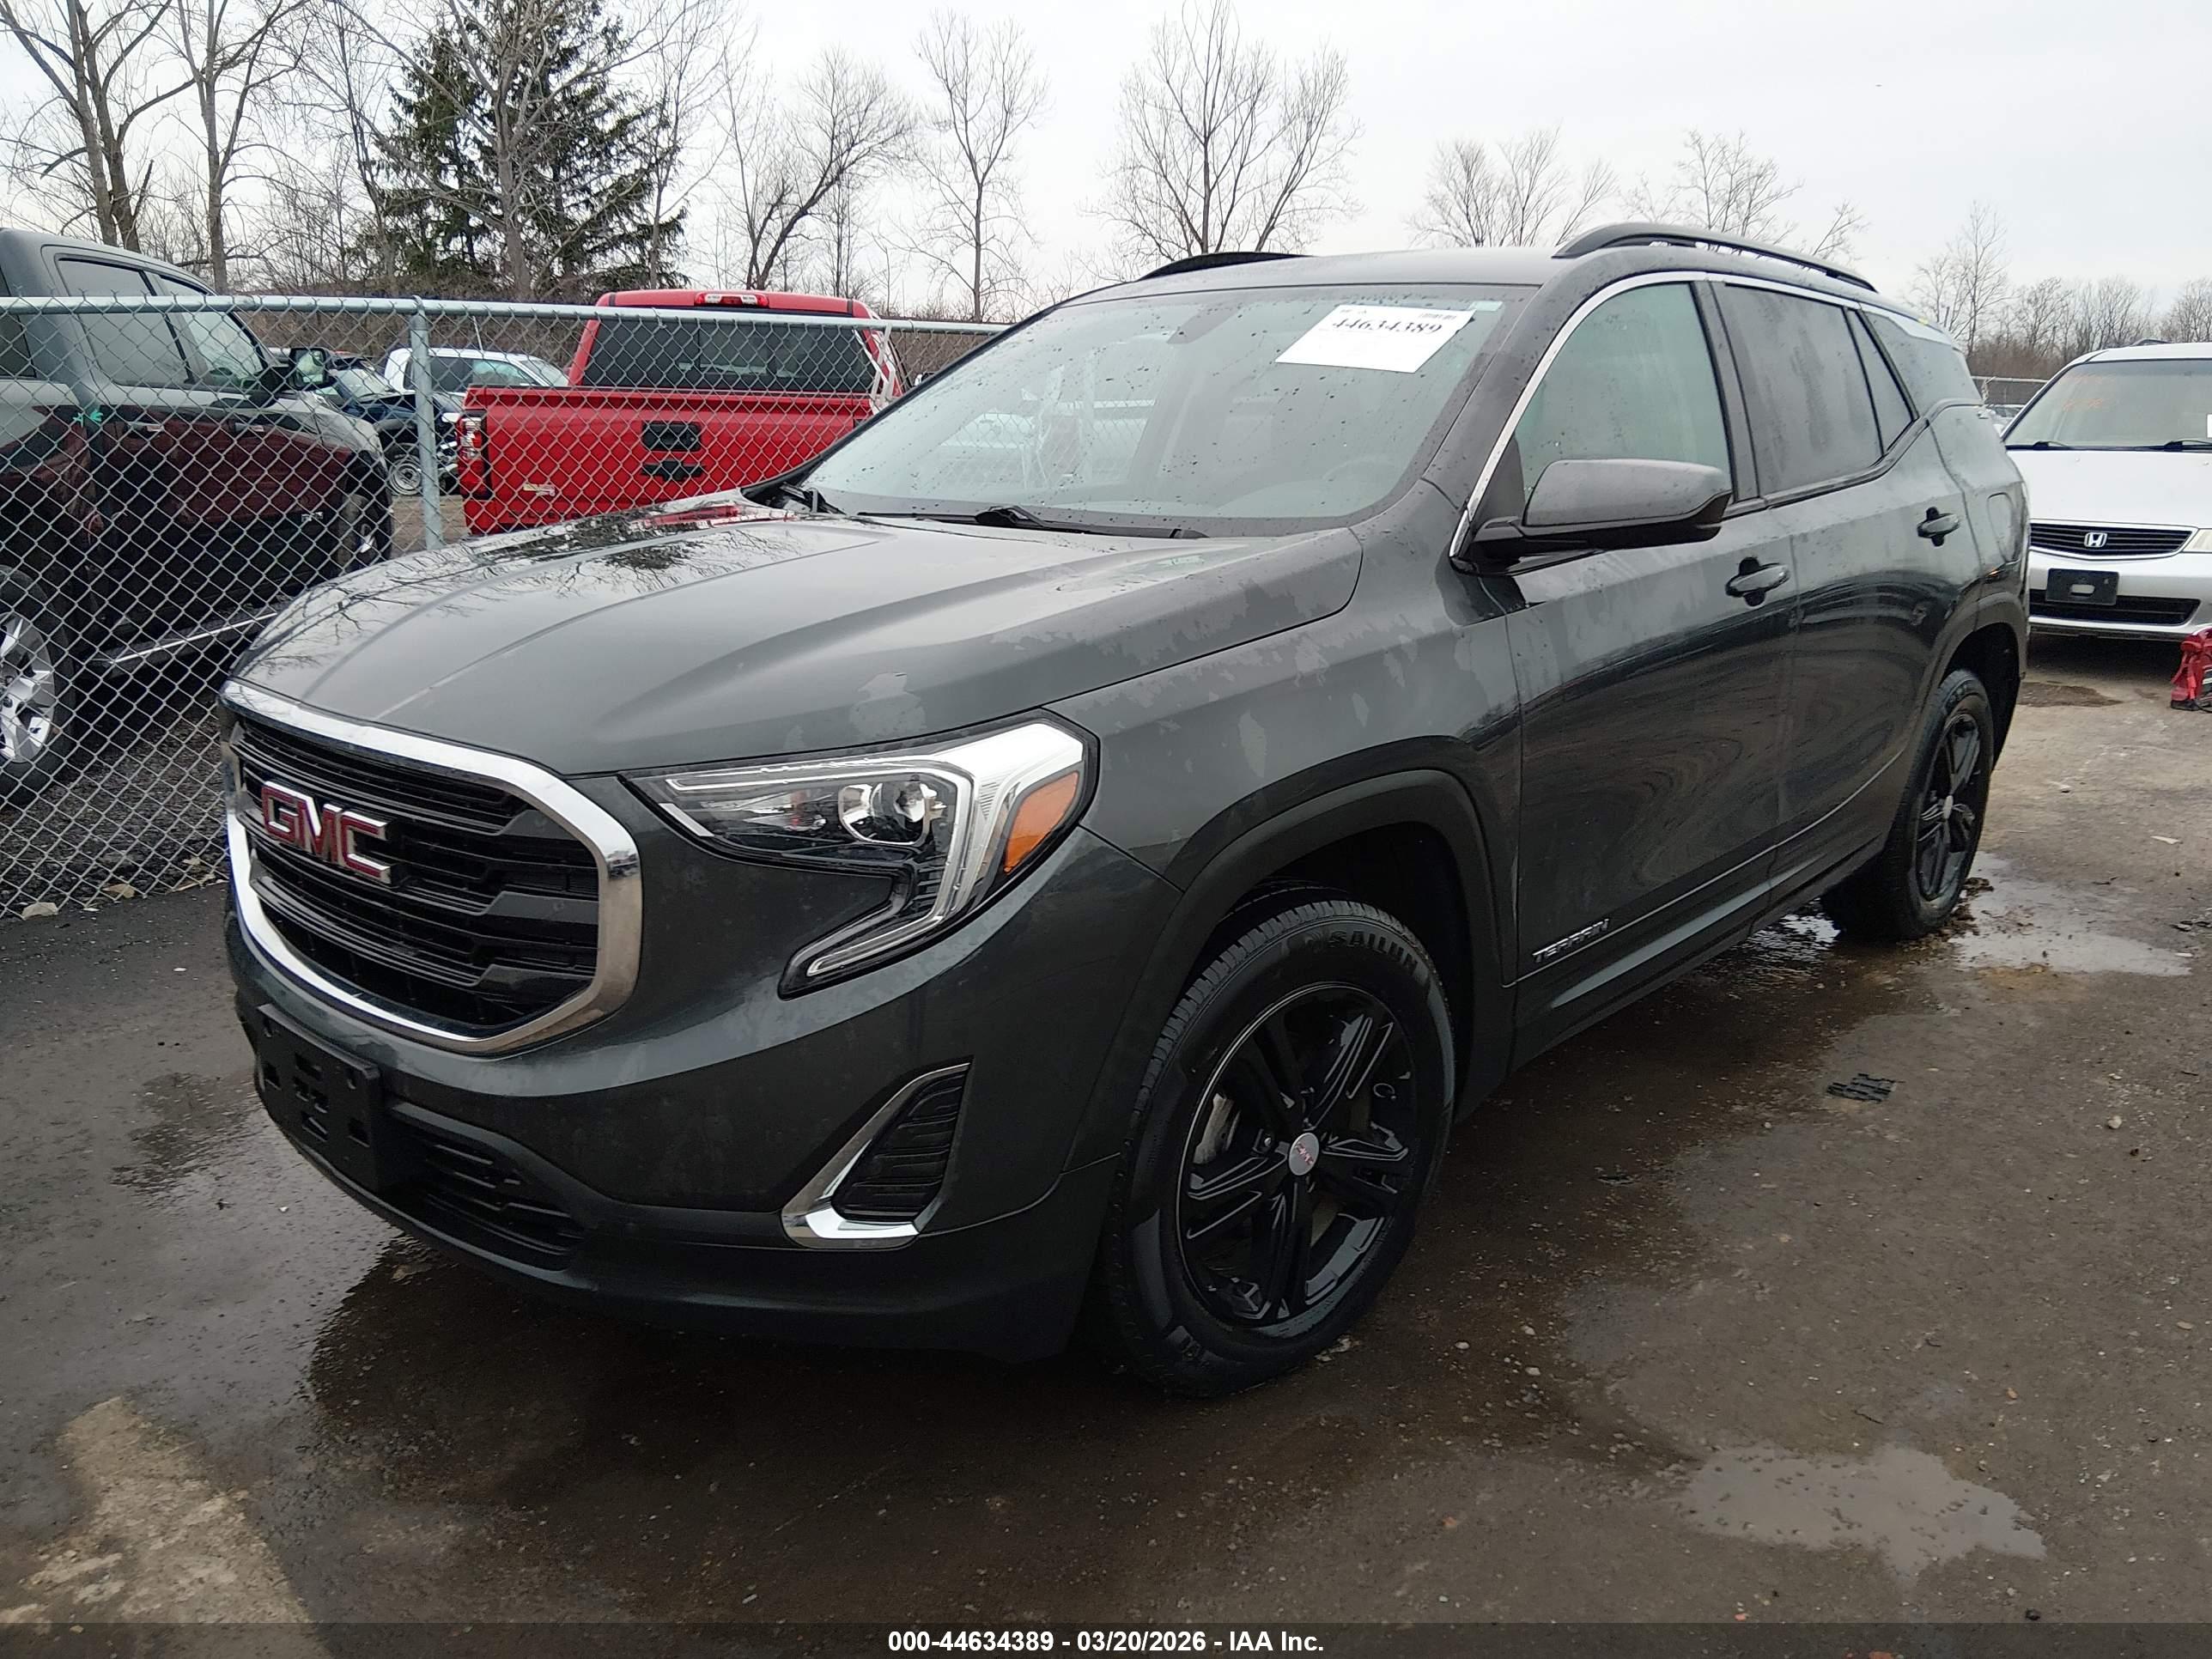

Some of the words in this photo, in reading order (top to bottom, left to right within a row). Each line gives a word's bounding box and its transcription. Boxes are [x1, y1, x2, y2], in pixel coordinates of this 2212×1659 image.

[1332, 318, 1443, 334] 44634389
[261, 781, 392, 884] GMC
[1328, 930, 1418, 976] SAILUN
